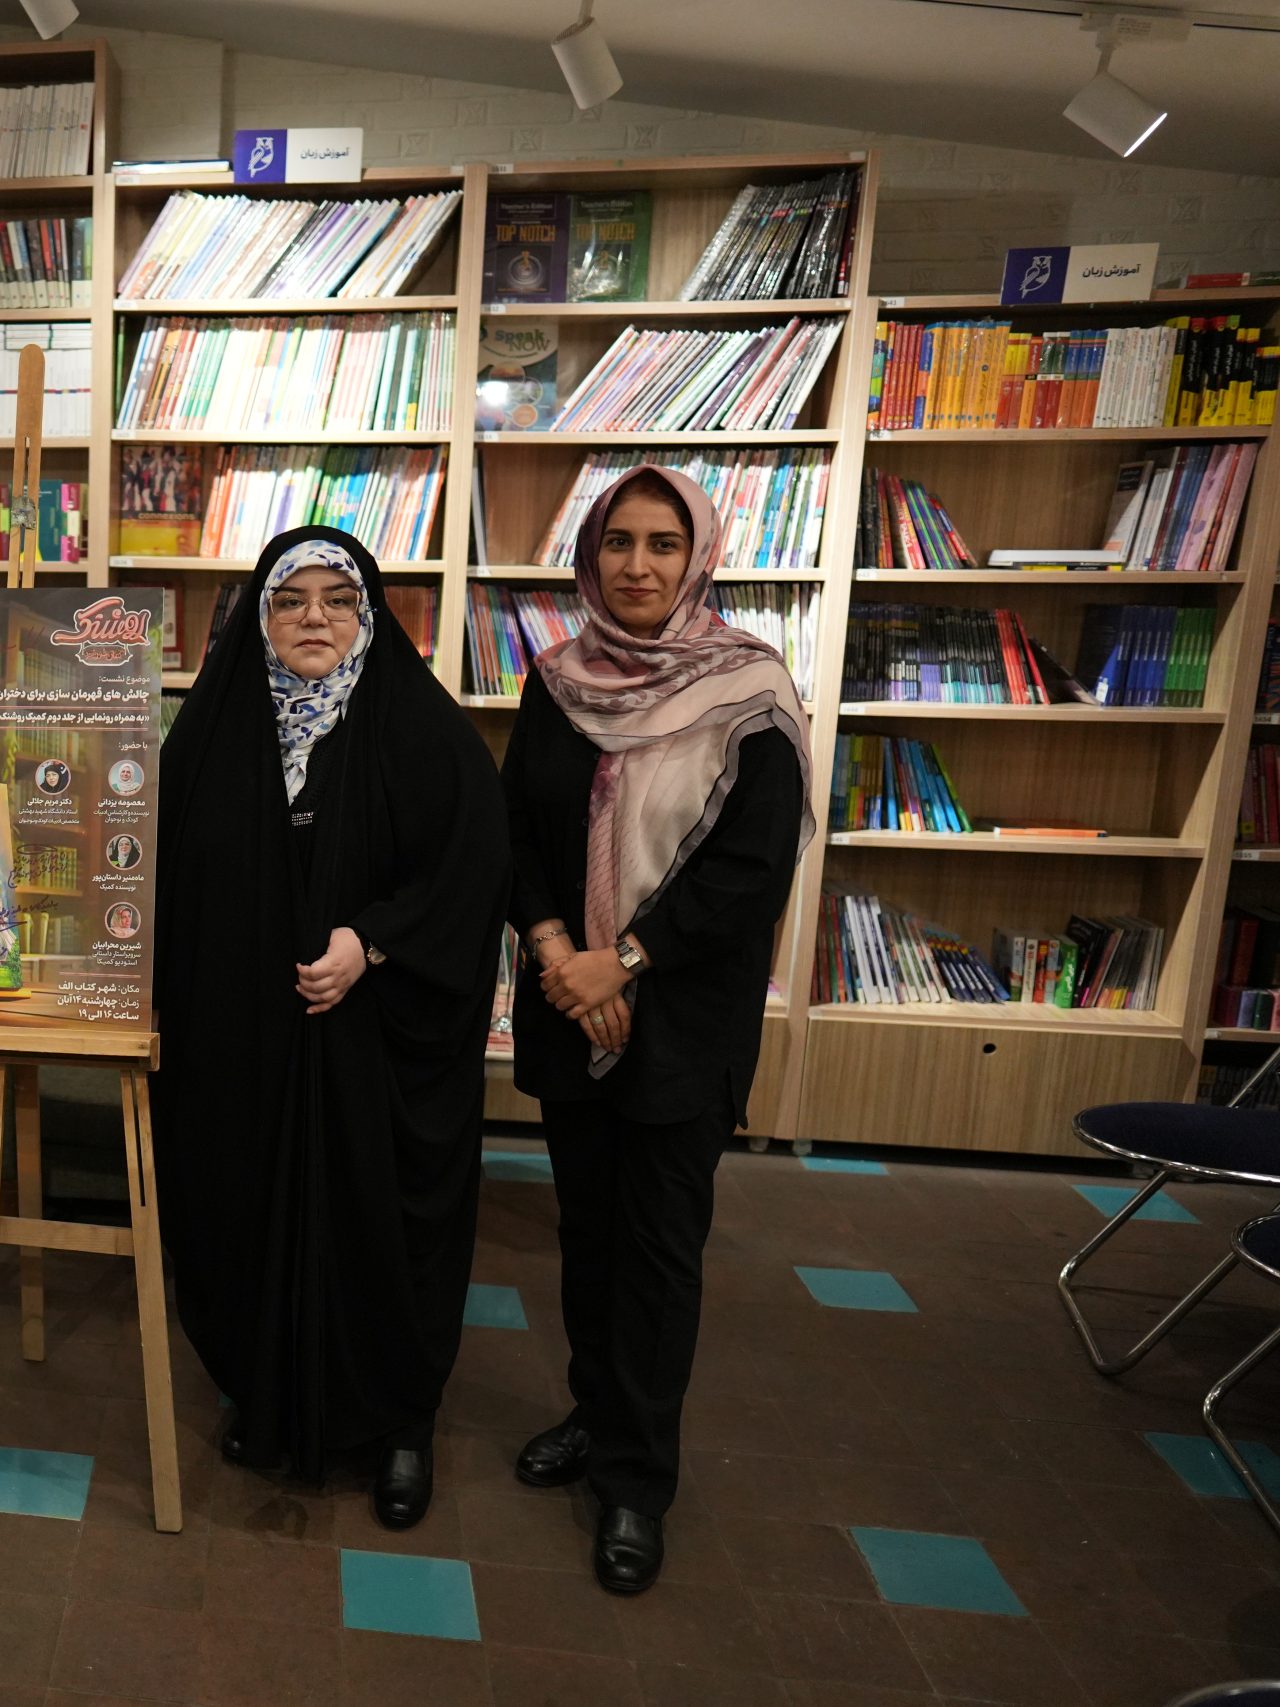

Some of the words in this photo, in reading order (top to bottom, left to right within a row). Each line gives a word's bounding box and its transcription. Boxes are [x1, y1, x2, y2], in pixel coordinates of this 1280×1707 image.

[300, 148, 318, 160] زبان
[320, 147, 349, 160] آموزش
[496, 225, 516, 241] TOP
[520, 225, 556, 242] NOTCH
[599, 223, 636, 240] NOTCH
[1082, 266, 1103, 277] زبان
[1104, 263, 1141, 276] آموزش
[509, 339, 549, 352] NOW
[53, 597, 151, 646] روشنک
[99, 675, 125, 683] نشست:
[126, 676, 151, 685] موضوع
[27, 689, 46, 702] برای
[47, 689, 70, 702] سازی
[71, 687, 102, 702] قهرمان
[103, 690, 121, 701] های
[122, 689, 150, 704] چالش
[25, 712, 46, 723] کمیک
[46, 714, 62, 724] دوم
[62, 713, 76, 723] جلد
[77, 713, 84, 723] از
[84, 713, 114, 724] رونمایی
[114, 713, 136, 723] همراه
[118, 742, 142, 751] حضور:
[142, 742, 148, 750] با
[27, 797, 44, 806] جلالی
[44, 799, 59, 807] مریم
[59, 798, 73, 806] دکتر
[97, 798, 118, 808] یزدانی
[117, 799, 146, 807] معصومه
[104, 816, 121, 824] نوجوان
[115, 884, 136, 892] نویسنده
[92, 941, 120, 950] محرابیان
[119, 942, 142, 951] شیرین
[58, 980, 74, 991] الف
[74, 982, 97, 992] کتاب
[97, 984, 117, 994] شهر
[118, 984, 140, 995] مکان:
[57, 994, 73, 1006] آبان
[73, 995, 82, 1004] ۱۴
[81, 996, 118, 1009] چهارشنبه
[118, 999, 140, 1009] زمان:
[79, 1008, 88, 1017] ۱۹
[88, 1009, 103, 1021] الی
[113, 1010, 140, 1020] ساعت
